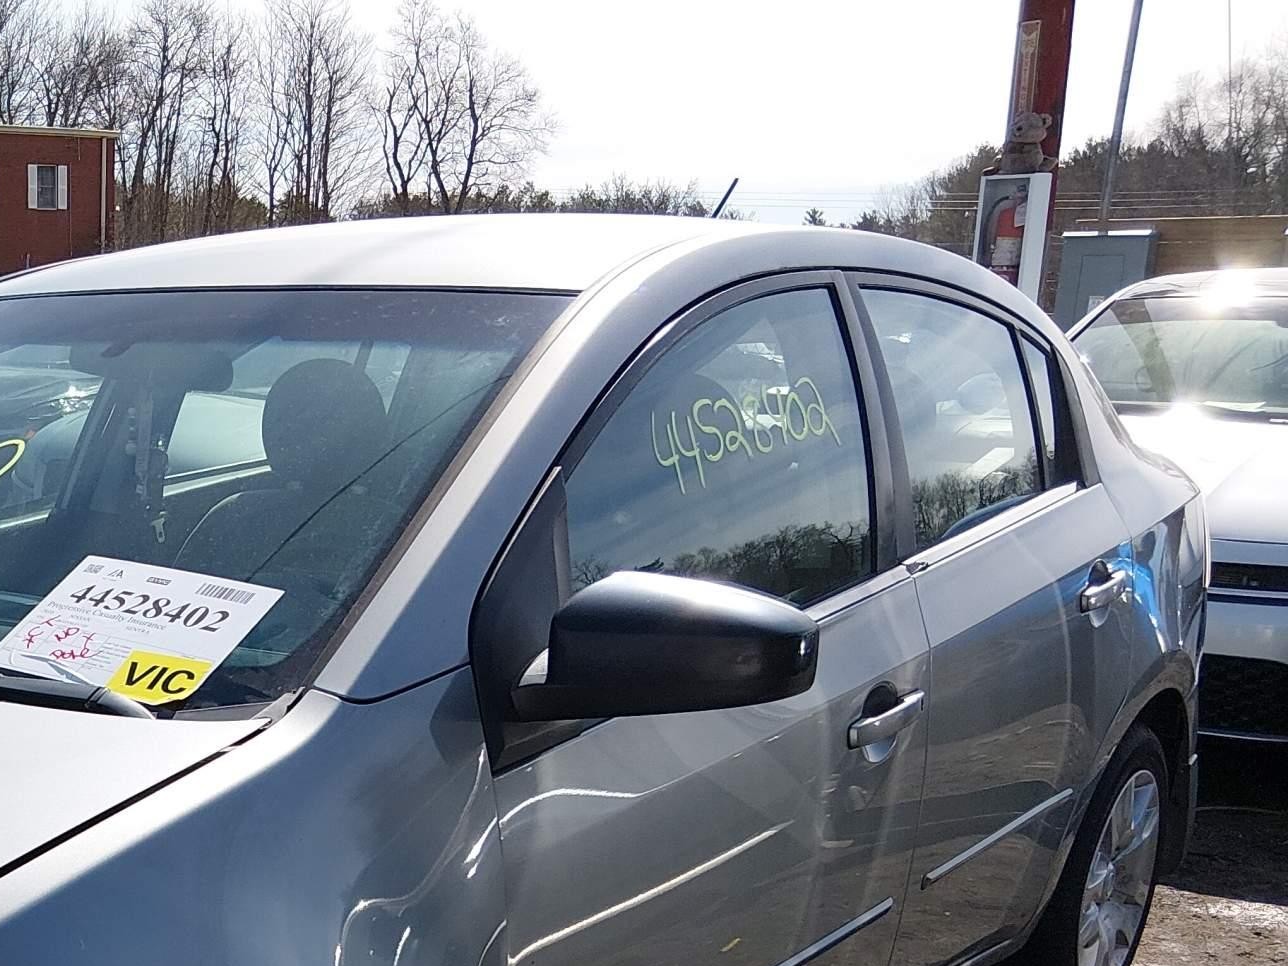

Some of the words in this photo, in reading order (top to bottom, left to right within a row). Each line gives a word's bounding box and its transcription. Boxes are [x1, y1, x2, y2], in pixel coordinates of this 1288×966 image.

[651, 376, 842, 495] 44528402
[70, 584, 230, 633] 44528402
[125, 661, 195, 695] VIC
